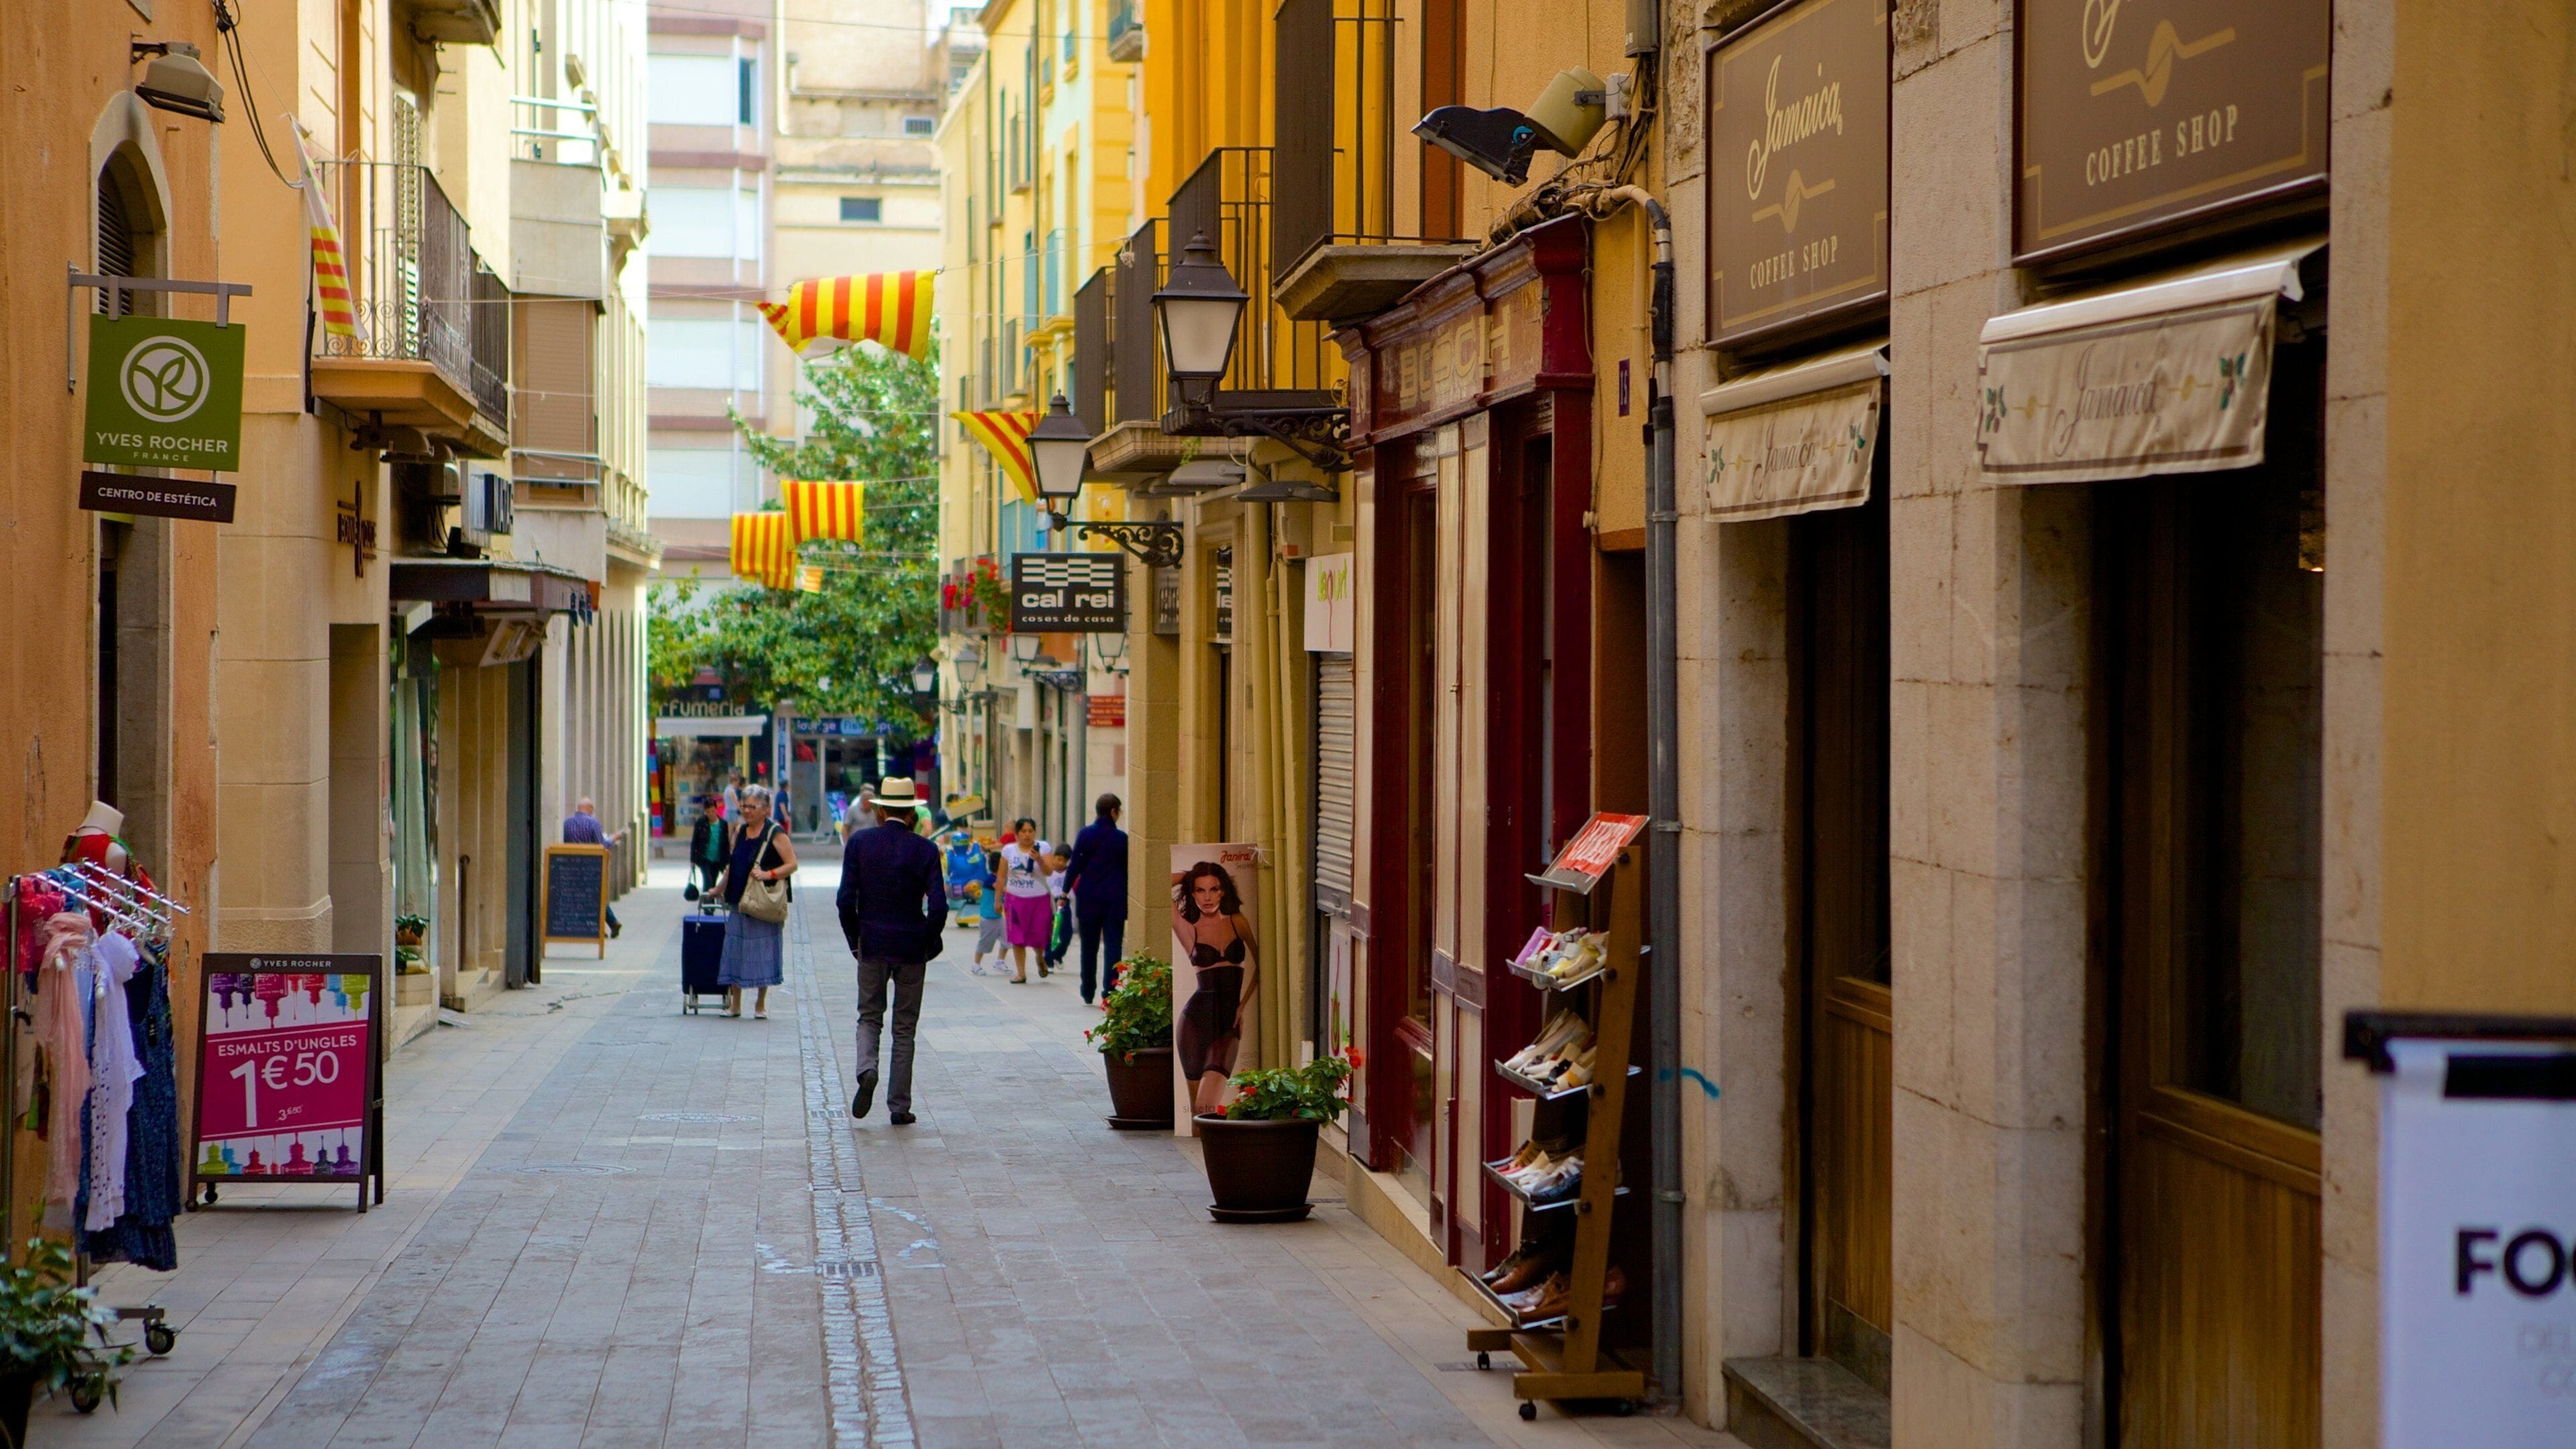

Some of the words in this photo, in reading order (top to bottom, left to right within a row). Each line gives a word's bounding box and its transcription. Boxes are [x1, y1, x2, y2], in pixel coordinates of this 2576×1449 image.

[1748, 54, 1843, 201] Jamaica
[2086, 129, 2162, 186] COFFEE
[2176, 104, 2238, 158] SHOP
[1750, 250, 1794, 290] COFFEE
[1803, 235, 1838, 272] SHOP
[96, 431, 143, 447] YVES
[150, 435, 228, 453] ROCHER
[133, 451, 189, 462] FRANCE
[98, 487, 145, 500] CENTRO
[146, 491, 162, 502] DE
[164, 492, 217, 507] ESTÉTICA
[1022, 589, 1063, 608] cal
[1075, 589, 1114, 608] rei
[1064, 614, 1080, 623] de
[1220, 850, 1251, 864] Janira
[218, 1041, 280, 1057] ESMALTS
[284, 1034, 357, 1052] D'UNGLES
[2455, 1229, 2576, 1297] FO
